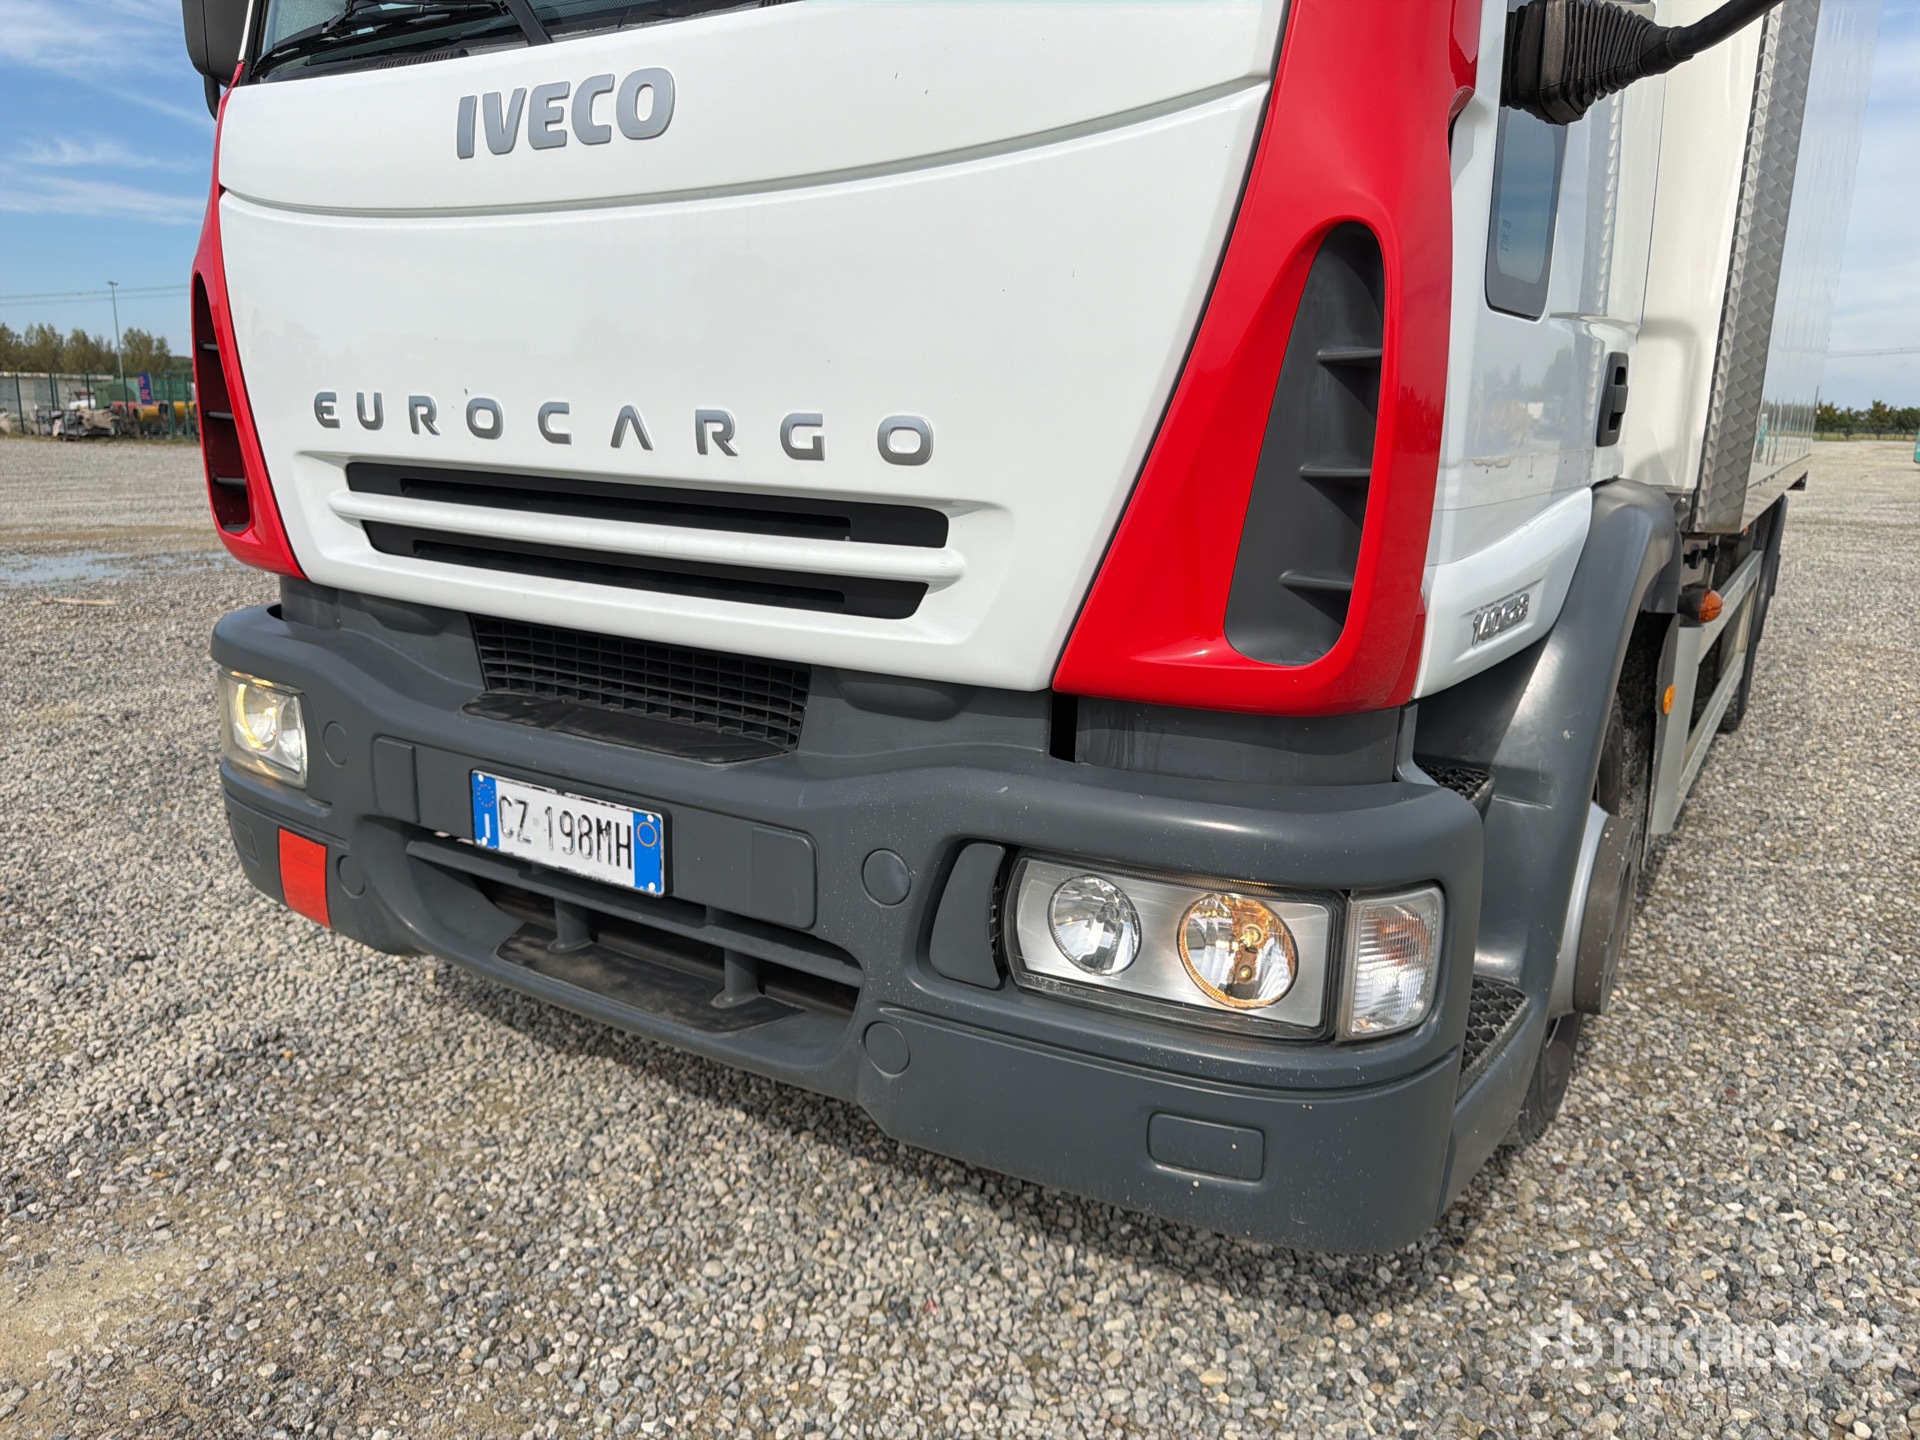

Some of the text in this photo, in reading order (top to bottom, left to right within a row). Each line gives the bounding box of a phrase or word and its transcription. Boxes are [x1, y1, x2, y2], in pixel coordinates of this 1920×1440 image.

[456, 67, 676, 160] IVECO
[313, 391, 934, 466] EUROCARGO
[544, 806, 632, 870] 198MH
